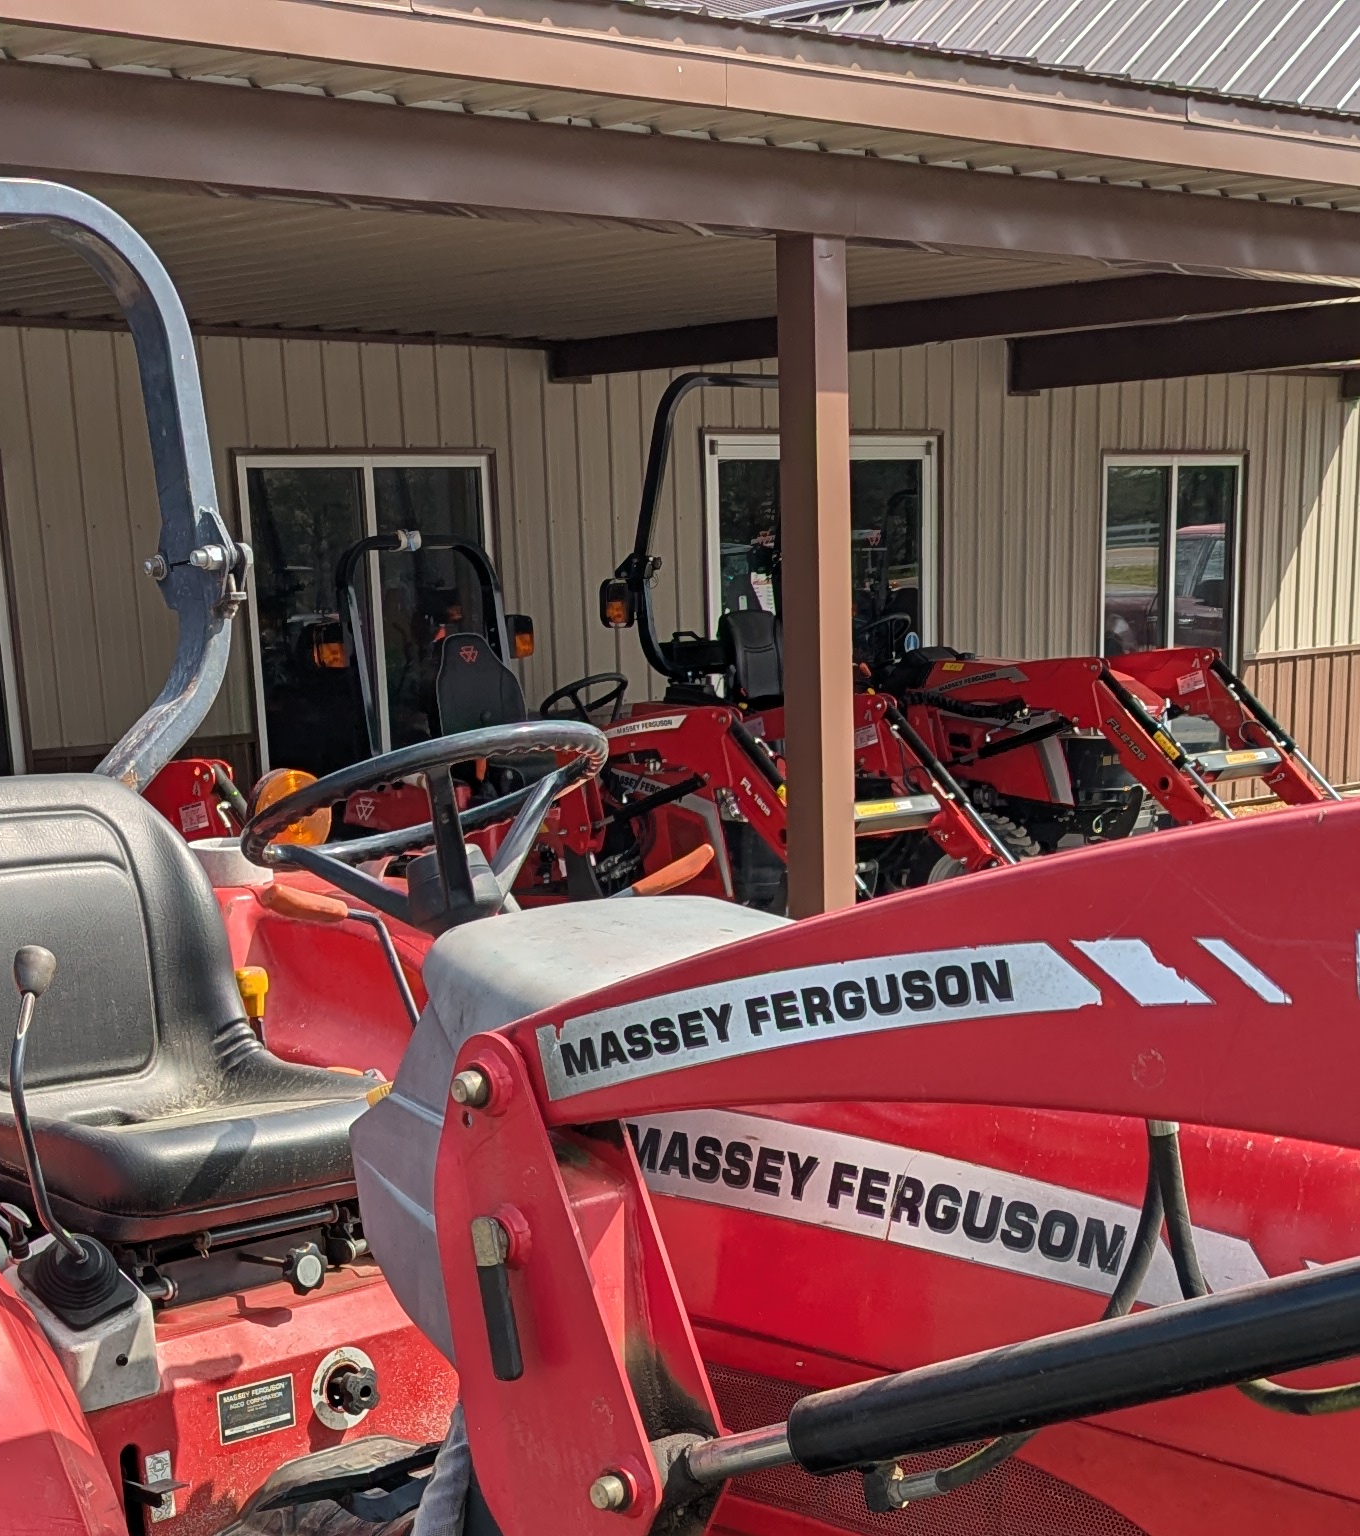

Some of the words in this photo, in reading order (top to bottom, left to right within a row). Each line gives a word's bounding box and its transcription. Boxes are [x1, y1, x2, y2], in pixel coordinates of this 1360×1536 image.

[616, 723, 640, 735] MASSEY
[641, 719, 673, 730] FERGUSON
[560, 1003, 732, 1078] MASSEY
[748, 957, 1014, 1037] FERGUSON
[625, 1124, 820, 1202] MASSEY
[827, 1161, 1128, 1276] FERGUSON
